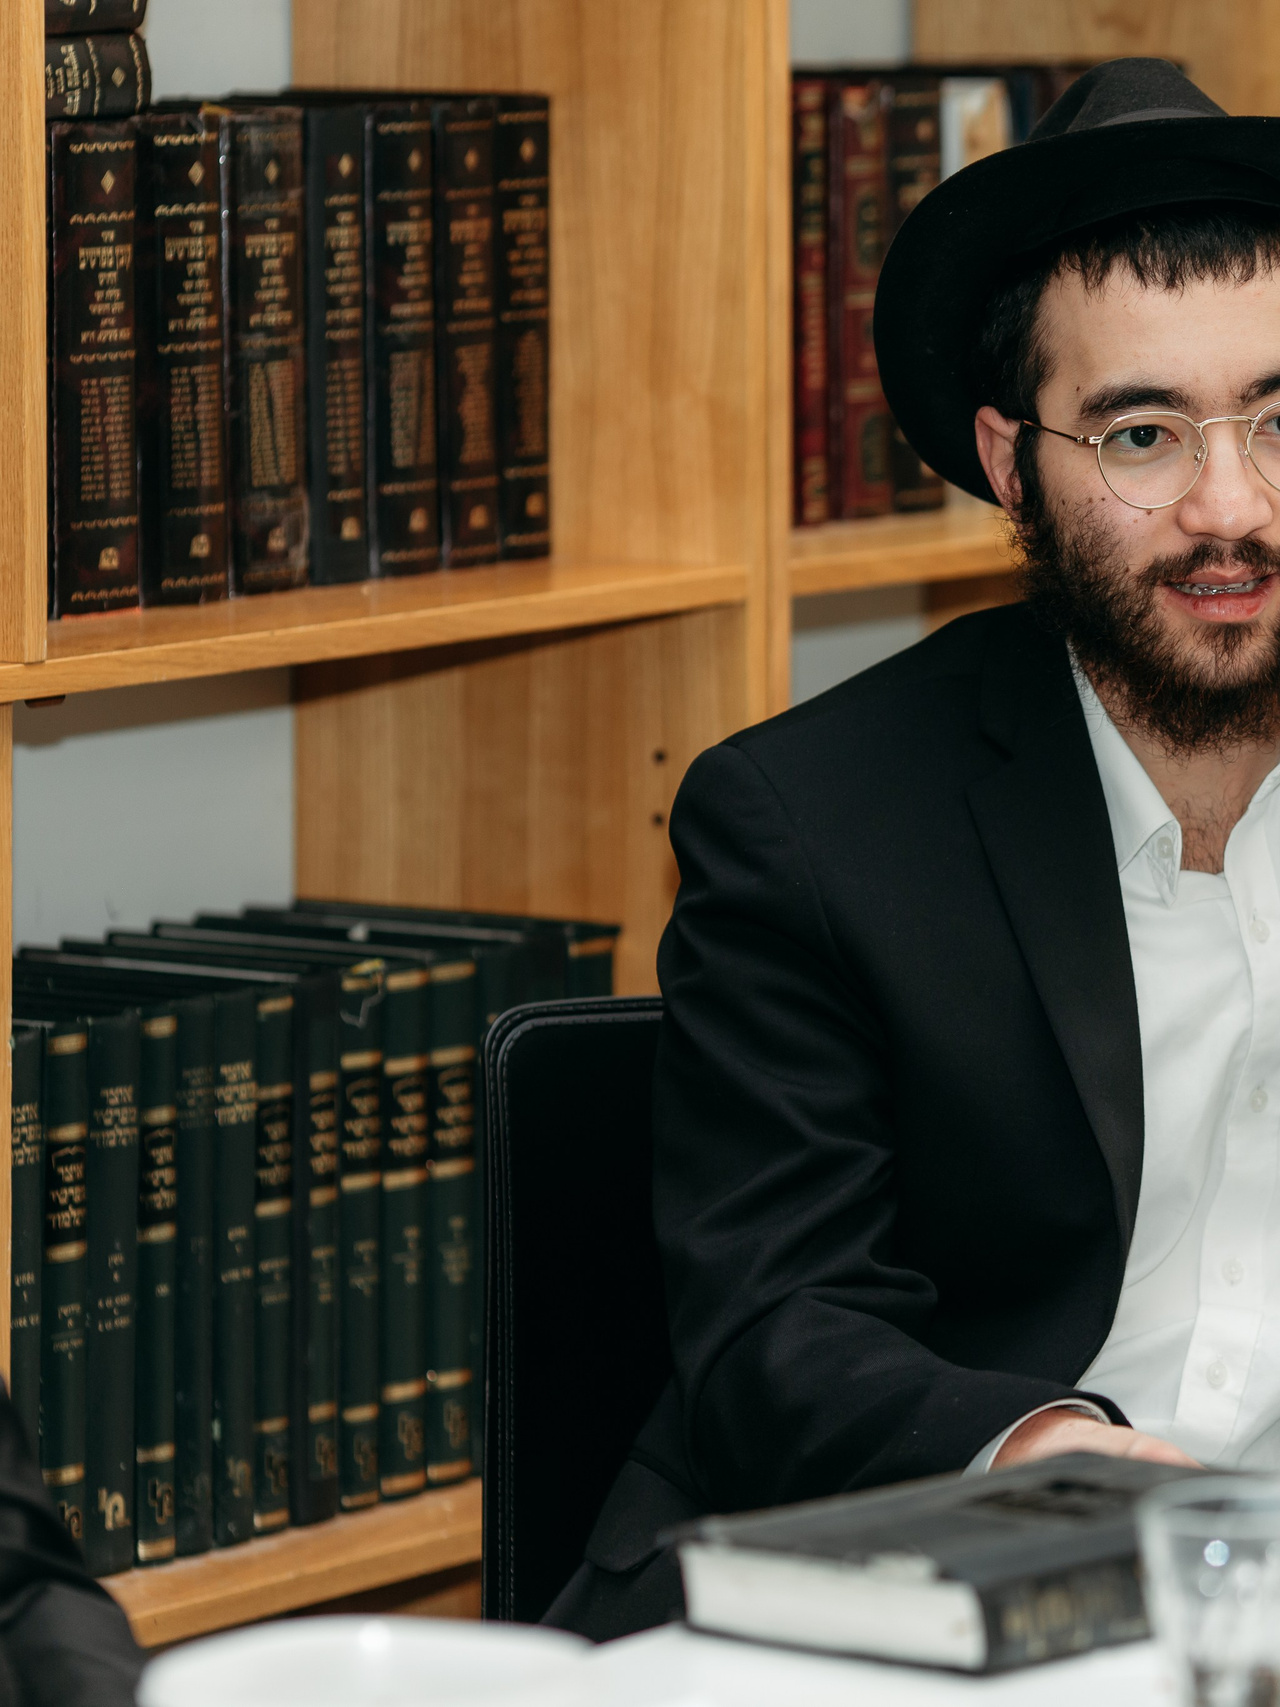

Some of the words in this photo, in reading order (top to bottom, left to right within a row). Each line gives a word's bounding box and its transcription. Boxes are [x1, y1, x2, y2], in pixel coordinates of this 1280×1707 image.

[220, 1060, 253, 1083] אוצר
[100, 1084, 133, 1106] אוצר
[214, 1082, 257, 1104] מפרשי
[93, 1106, 137, 1126] מפרשי
[214, 1101, 257, 1127] התלמוד
[12, 1123, 41, 1145] מפרש
[90, 1124, 137, 1149] התלמוד
[56, 1162, 84, 1183] אוצר
